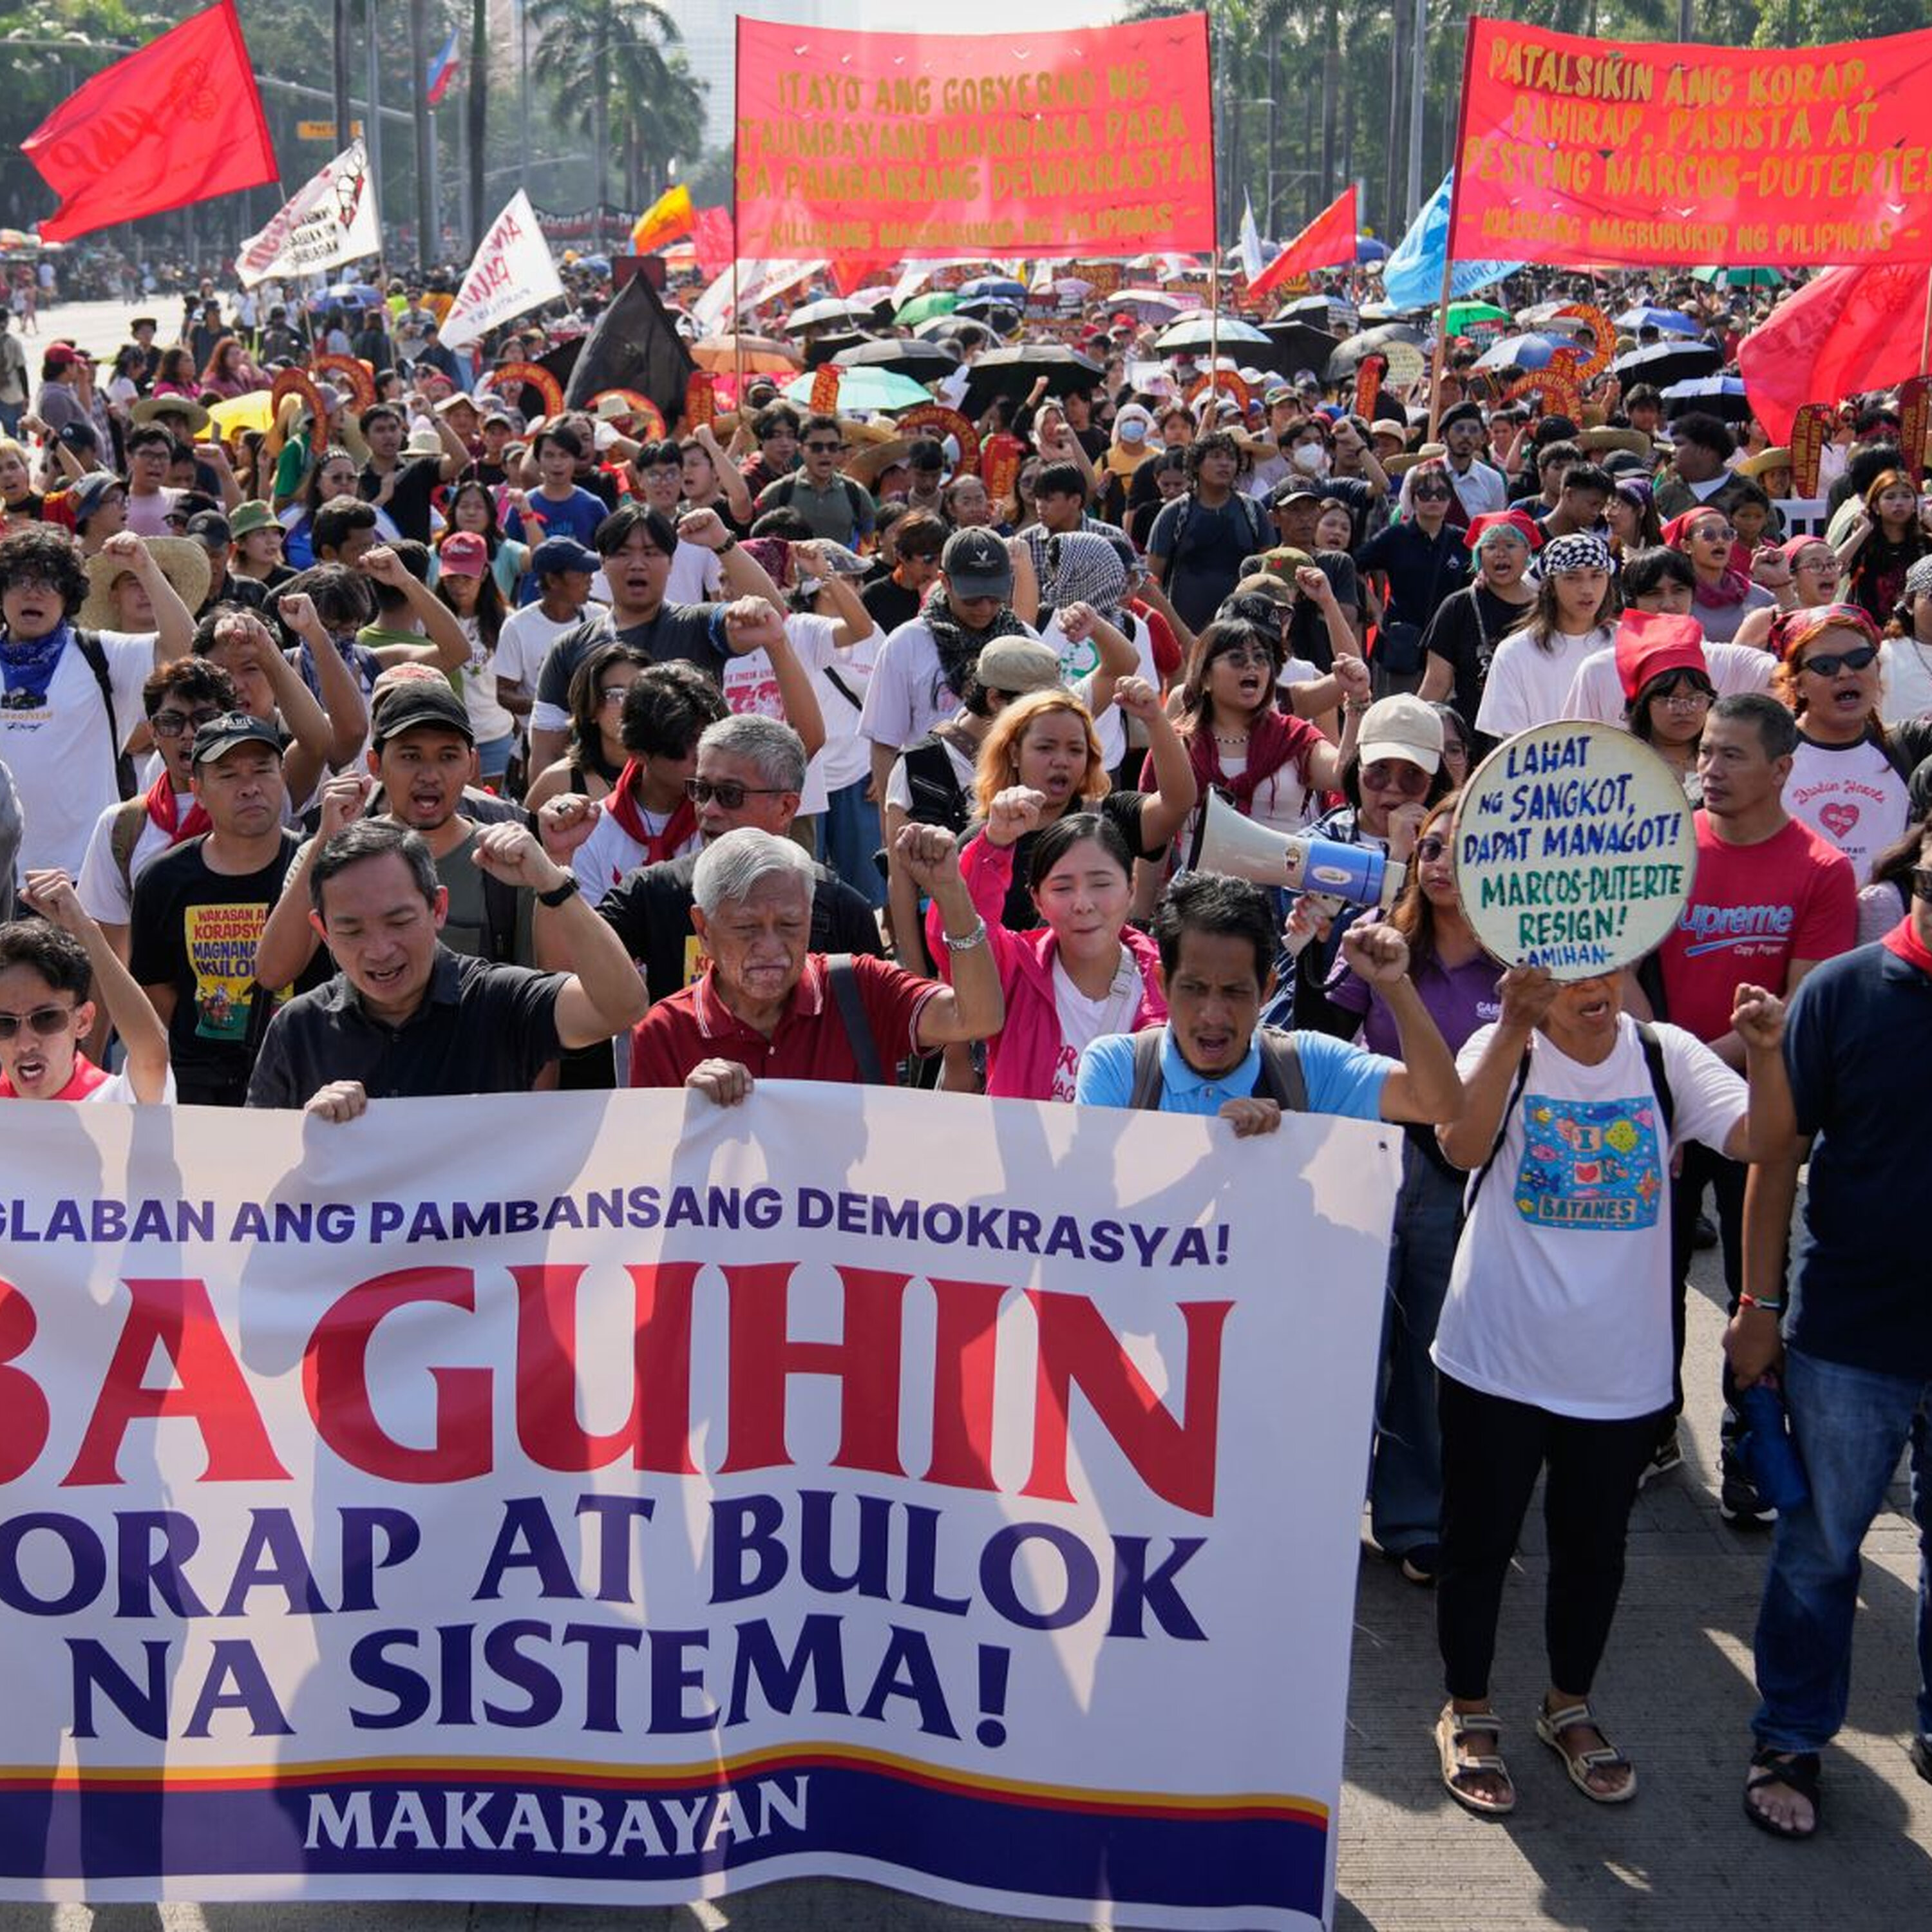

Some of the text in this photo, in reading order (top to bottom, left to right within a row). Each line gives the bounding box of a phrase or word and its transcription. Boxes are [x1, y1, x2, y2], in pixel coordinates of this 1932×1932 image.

[778, 61, 1150, 115] ITAYO ANG GOBYERNO NG
[1488, 37, 1873, 106] PATALSIKIN ANG KORAP,
[938, 114, 1093, 160] MAKIBAKA
[1106, 100, 1186, 146] PARA
[1669, 105, 1813, 151] PASISTA
[1826, 101, 1879, 147] AT
[736, 163, 771, 202] SA
[786, 163, 981, 202] PAMBANSANG
[1462, 135, 1593, 193] PESTENG
[1736, 223, 1768, 252] NG
[1776, 220, 1893, 254] PILIPINAS
[1506, 736, 1591, 779] LAHAT
[1478, 773, 1636, 824] NG SANGKOT,
[1464, 812, 1681, 867] DAPAT MANAGOT!
[1481, 864, 1684, 909] MARCOS-DUTERTE
[198, 909, 252, 922] WAKASAN
[1519, 905, 1627, 949] RESIGN!
[1680, 904, 1794, 940] upreme
[230, 1202, 355, 1243] ANG
[370, 1186, 782, 1244] PAMBANSANG
[797, 1188, 1230, 1267] DEMOKRASYA!
[472, 1493, 656, 1604] AT
[708, 1489, 1210, 1642] BULOK
[64, 1613, 1010, 1749] NA SISTEMA!
[304, 1774, 810, 1857] MAKABAYAN
